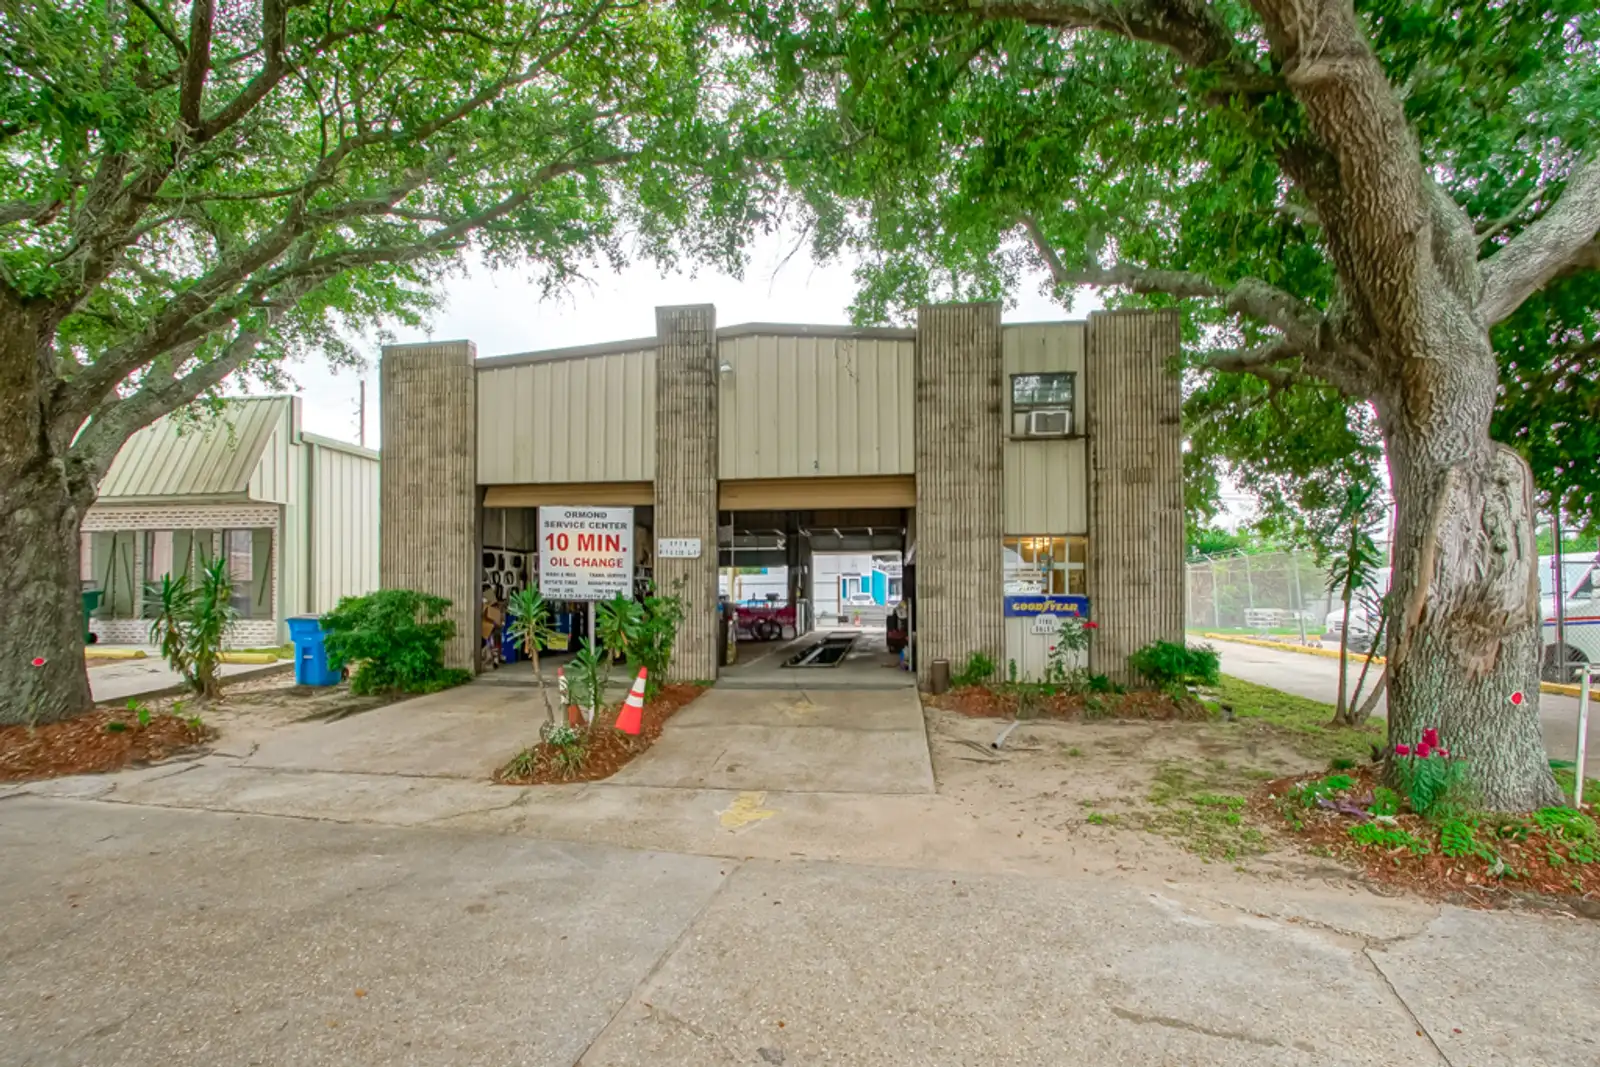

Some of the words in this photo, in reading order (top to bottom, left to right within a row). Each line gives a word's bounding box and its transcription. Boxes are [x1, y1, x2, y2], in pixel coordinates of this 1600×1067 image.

[564, 511, 608, 519] ORMOND
[544, 520, 585, 529] SERVICE
[588, 521, 628, 530] CENTER
[545, 532, 569, 551] 10
[577, 533, 627, 552] MIN.
[550, 556, 570, 567] OIL
[573, 557, 624, 568] CHANGE
[1012, 601, 1078, 612] GOODYEAR
